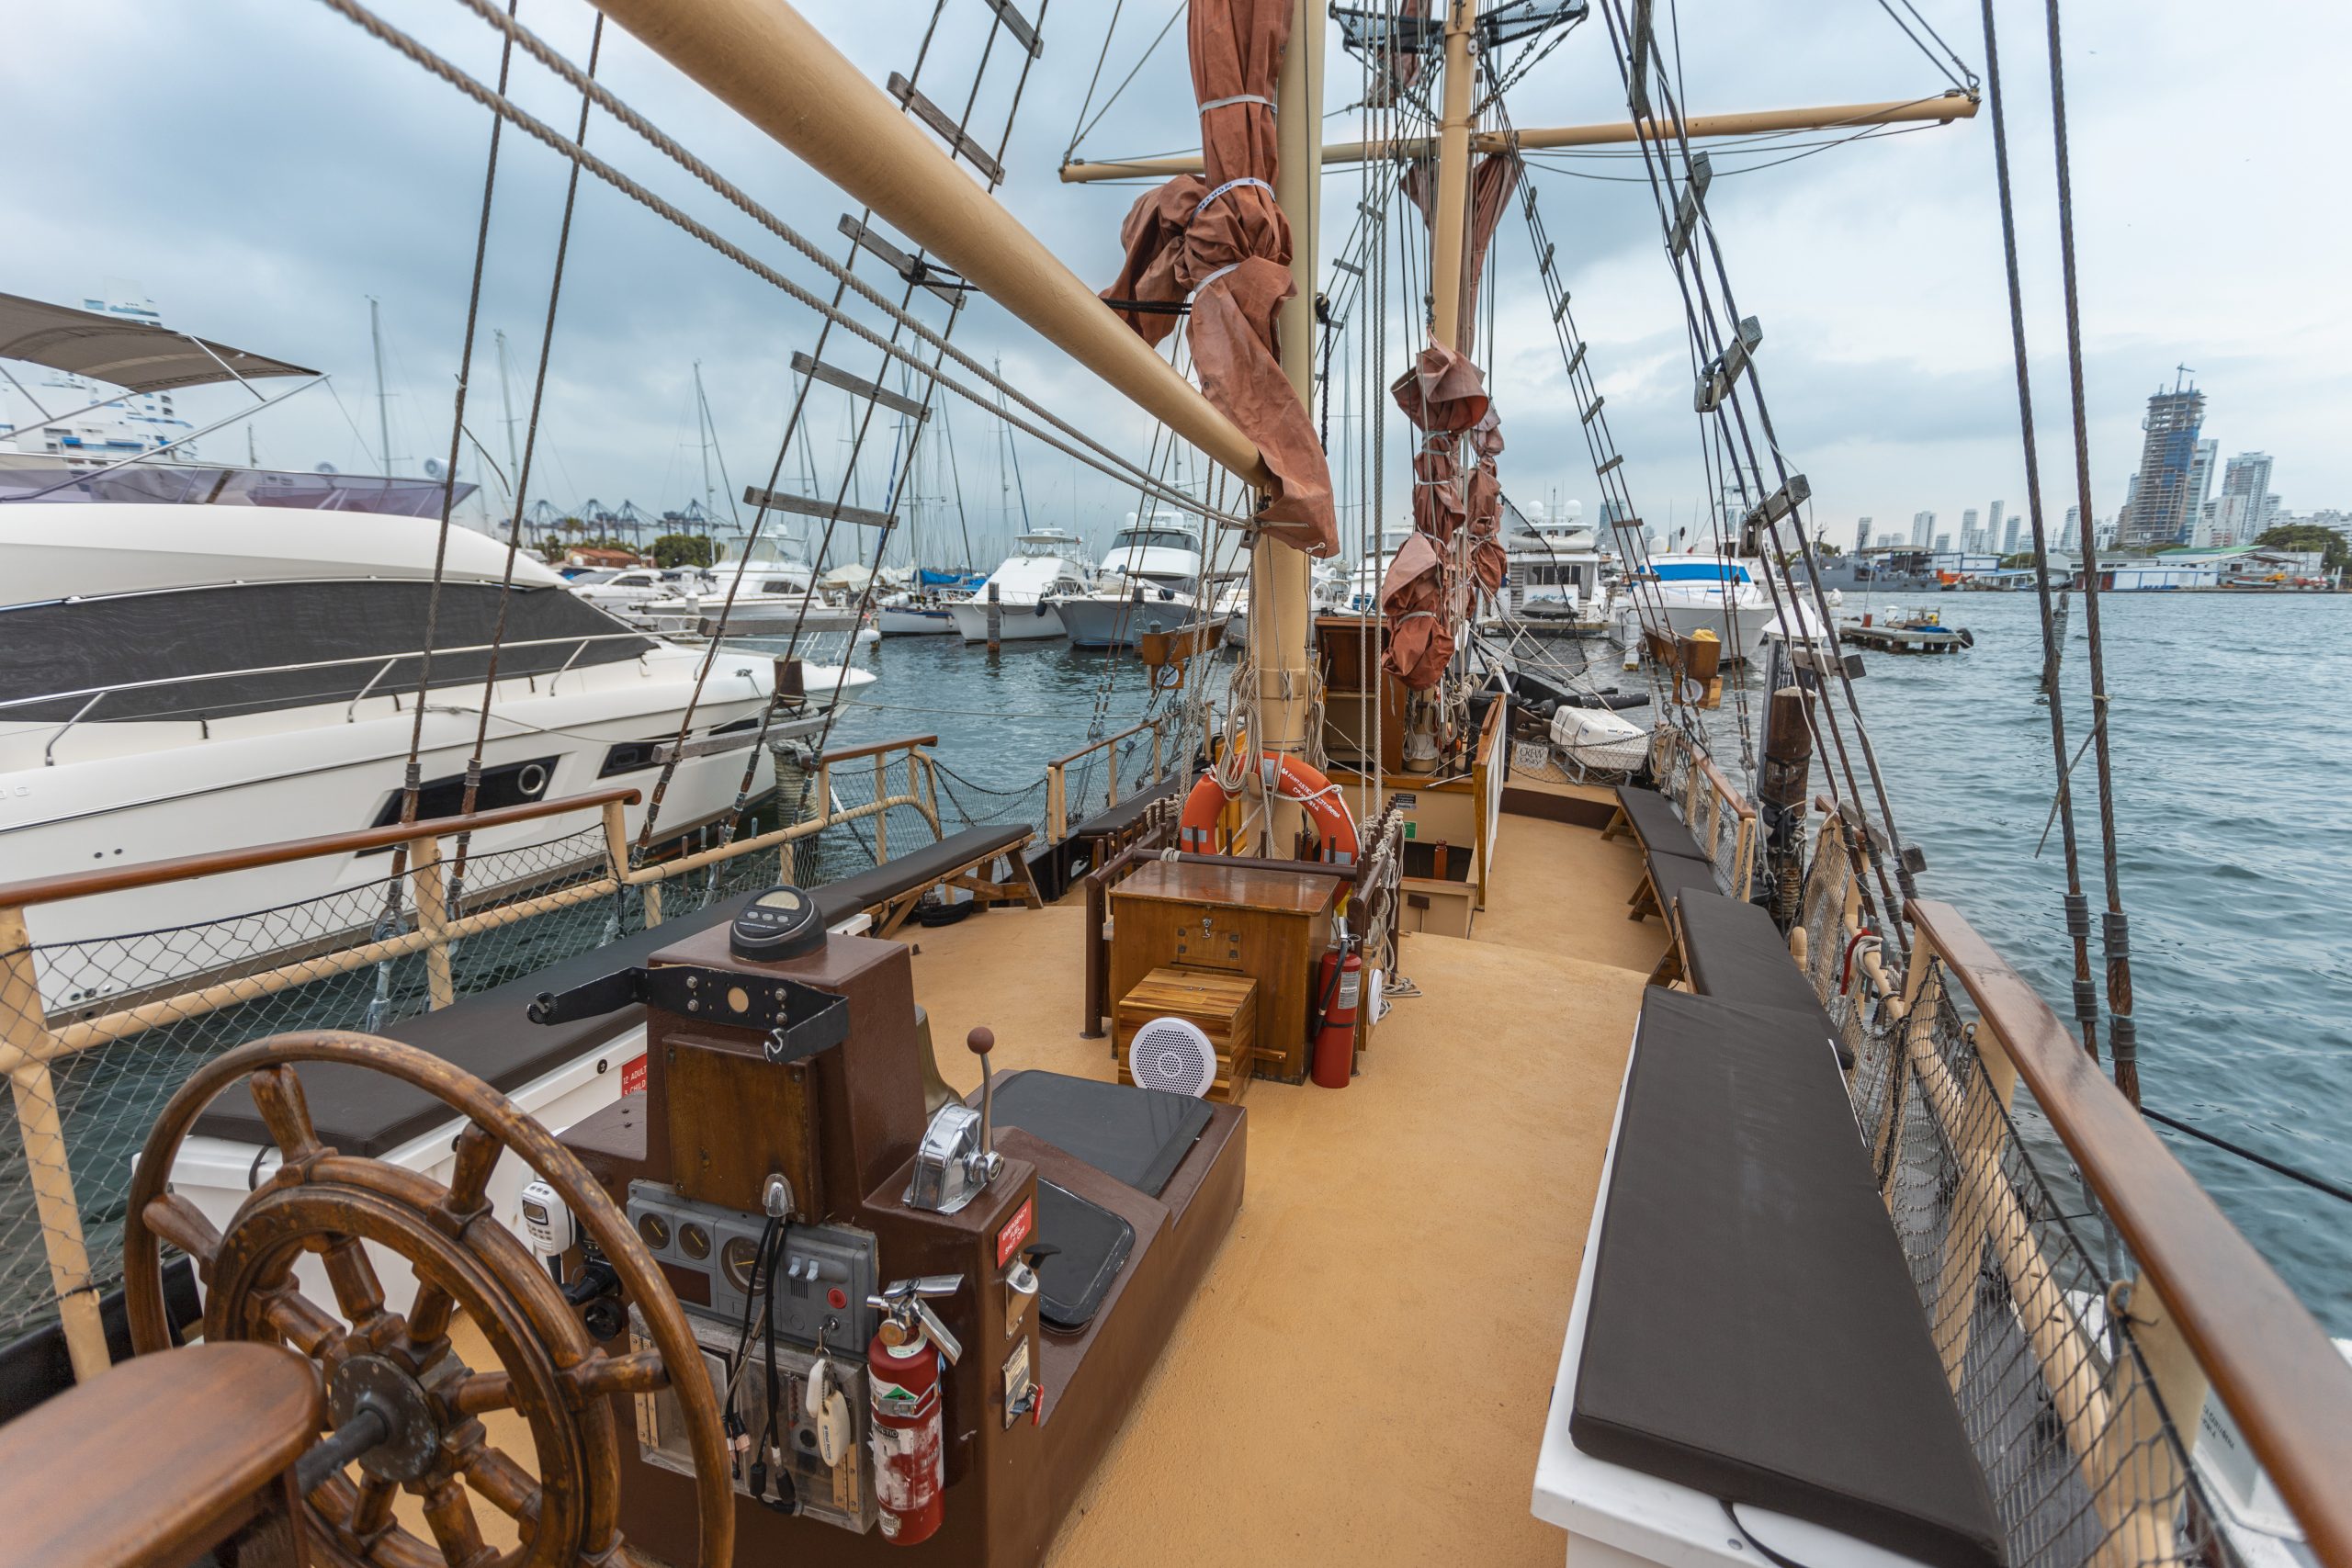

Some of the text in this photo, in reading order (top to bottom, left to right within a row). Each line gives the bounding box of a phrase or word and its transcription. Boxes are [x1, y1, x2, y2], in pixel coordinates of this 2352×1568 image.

[1520, 747, 1544, 759] CREW
[1002, 1207, 1028, 1241] EMERGENCY
[1010, 1225, 1021, 1241] FUEL
[1004, 1225, 1025, 1255] SHUT OFF
